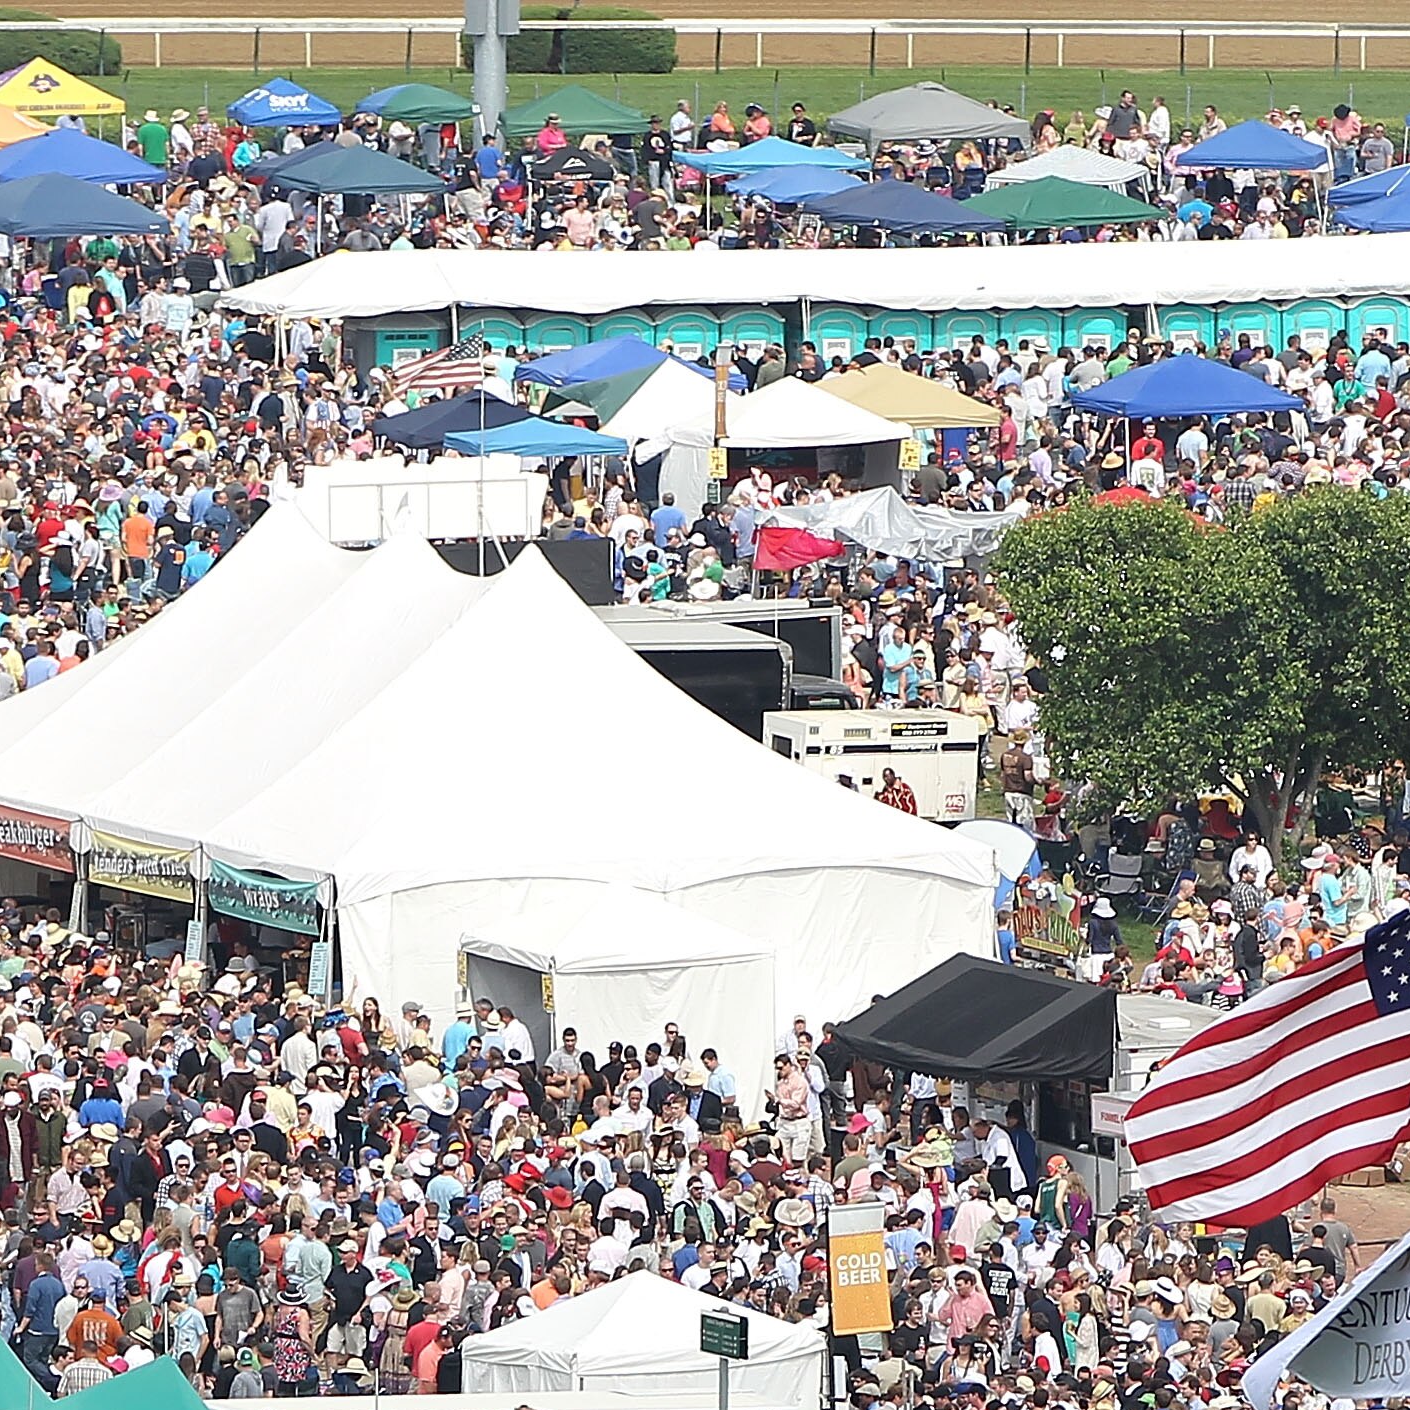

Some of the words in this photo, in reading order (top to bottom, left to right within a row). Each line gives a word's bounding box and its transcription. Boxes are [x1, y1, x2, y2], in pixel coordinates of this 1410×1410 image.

[94, 856, 133, 875] tenders
[135, 857, 159, 876] with
[161, 857, 187, 876] fries
[243, 887, 279, 909] wraps
[836, 1252, 882, 1271] COLD
[838, 1268, 881, 1287] BEER
